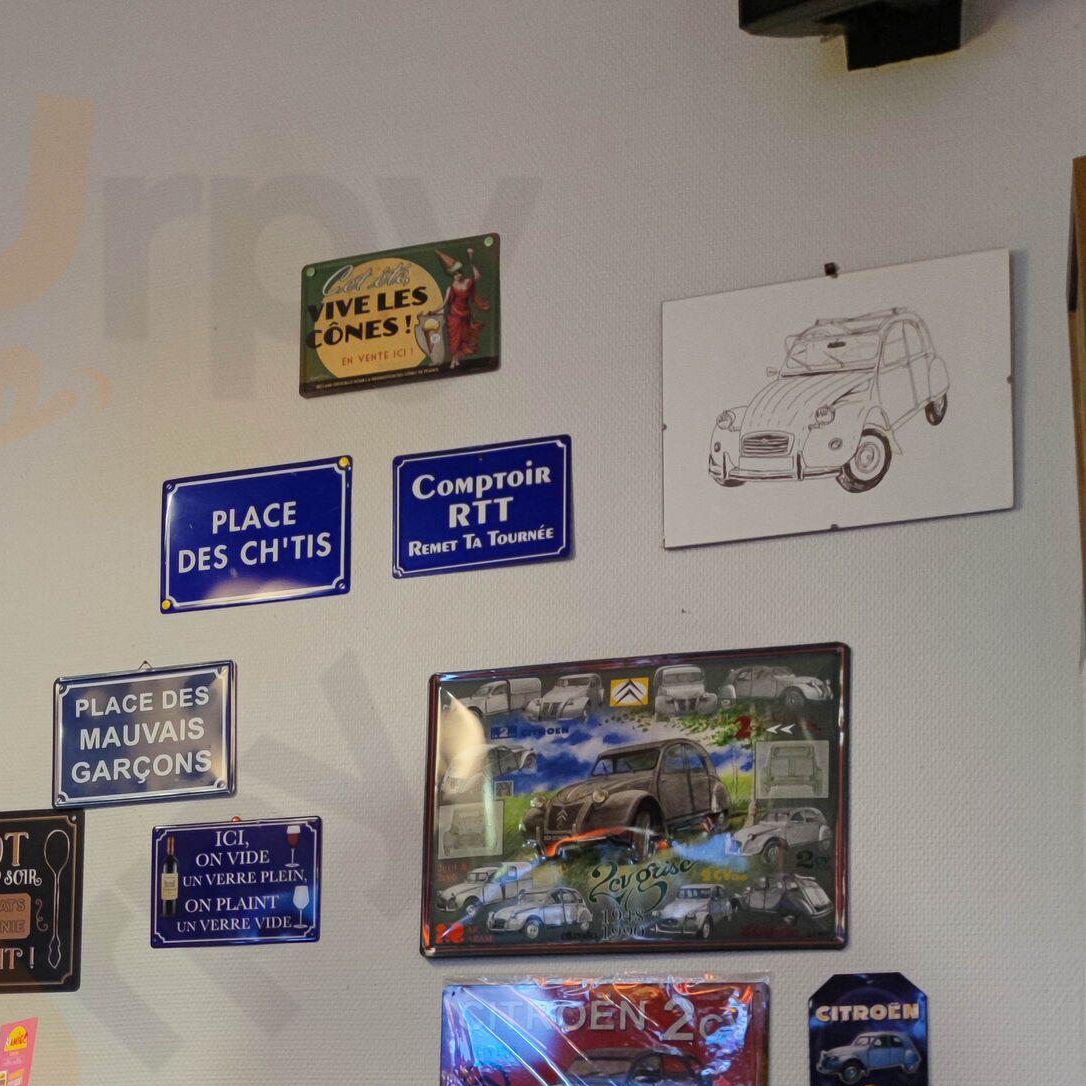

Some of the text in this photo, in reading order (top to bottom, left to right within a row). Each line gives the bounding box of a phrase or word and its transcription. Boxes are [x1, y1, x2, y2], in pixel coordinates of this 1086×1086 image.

[307, 286, 428, 322] VIVE LES
[306, 318, 399, 349] CÔNES
[341, 355, 354, 367] EN
[360, 351, 389, 364] VENTE
[393, 350, 407, 361] ICI
[212, 501, 297, 535] PLACE
[448, 496, 514, 529] RTT
[178, 531, 332, 574] DES CH'TIS
[75, 685, 210, 718] PLACE DES
[79, 717, 205, 751] MAUVAIS
[71, 750, 212, 784] GARÇONS
[214, 830, 250, 849] ICI,
[195, 849, 270, 868] ON VIDE
[3, 869, 43, 887] SOIR
[182, 869, 308, 888] UN VERRE PLEIN,
[185, 895, 280, 913] ON PLAINT
[176, 915, 292, 933] UN VERRE VIDE
[815, 1001, 921, 1022] CITROËN
